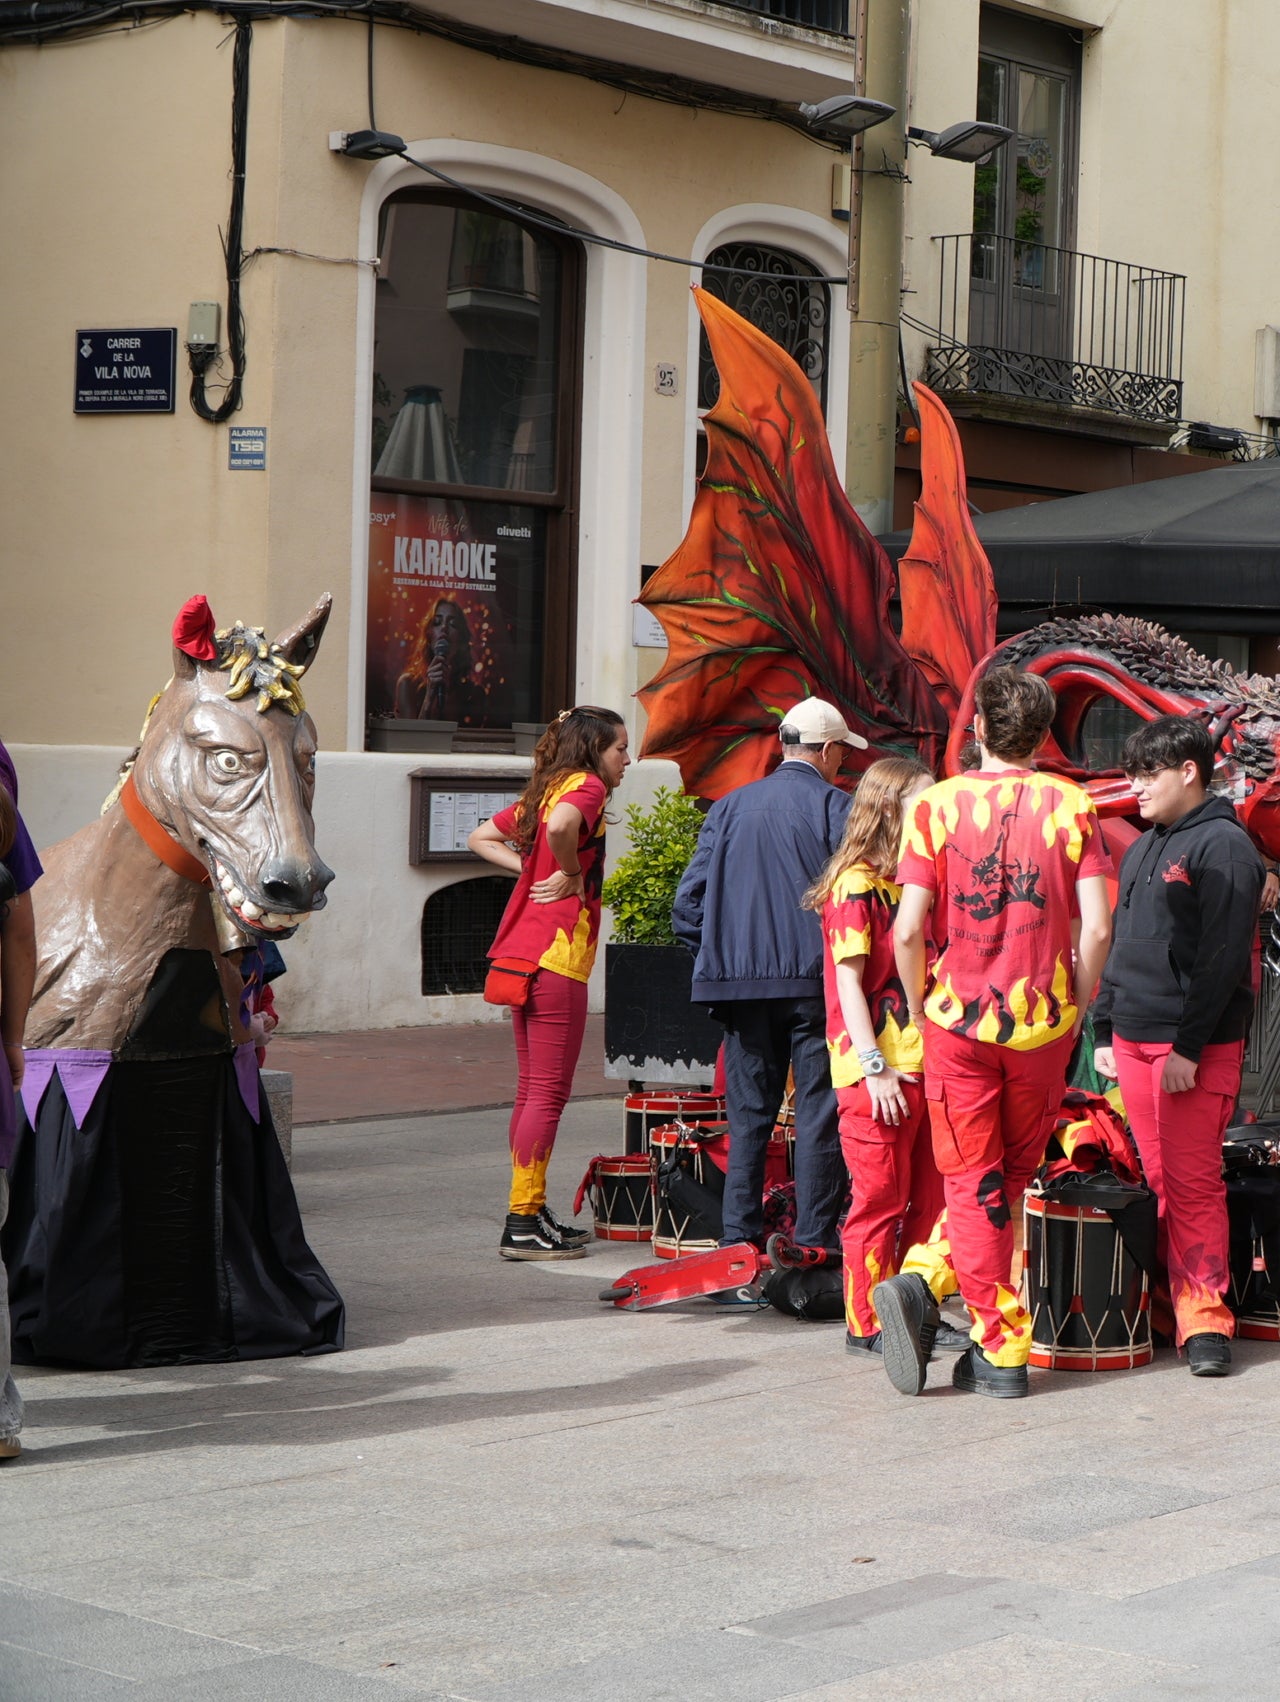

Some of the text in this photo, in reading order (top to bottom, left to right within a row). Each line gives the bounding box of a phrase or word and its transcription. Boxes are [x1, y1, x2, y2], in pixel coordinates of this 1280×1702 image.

[107, 338, 141, 349] CARRER
[113, 353, 135, 362] DE LA
[94, 365, 151, 379] VILA NOVA
[659, 369, 674, 388] 23
[231, 429, 264, 437] ALARMA
[496, 525, 532, 539] olivetti
[394, 535, 497, 581] KARAOKE
[966, 931, 981, 943] DEL
[982, 929, 1014, 944] TORRENT
[976, 944, 1010, 958] TERRASSA
